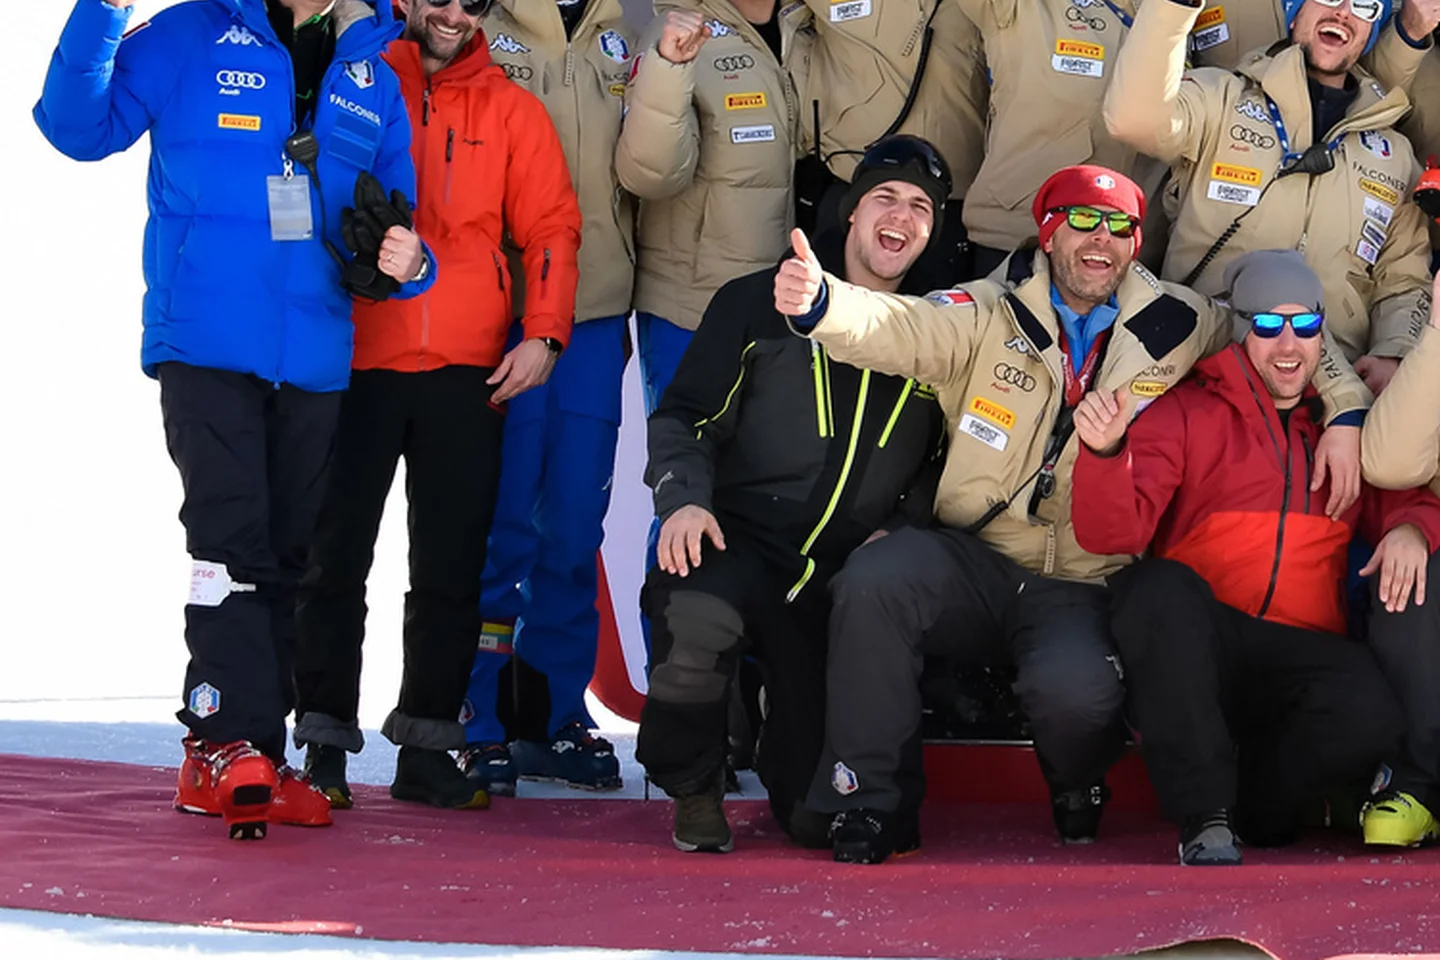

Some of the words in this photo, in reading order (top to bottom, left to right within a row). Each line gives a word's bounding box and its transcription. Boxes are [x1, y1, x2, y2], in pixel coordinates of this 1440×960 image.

[1059, 41, 1101, 57] PIRELLI
[728, 95, 764, 108] PIRELLI
[1215, 165, 1257, 182] PIRELLI
[974, 399, 1012, 426] PIRELLI
